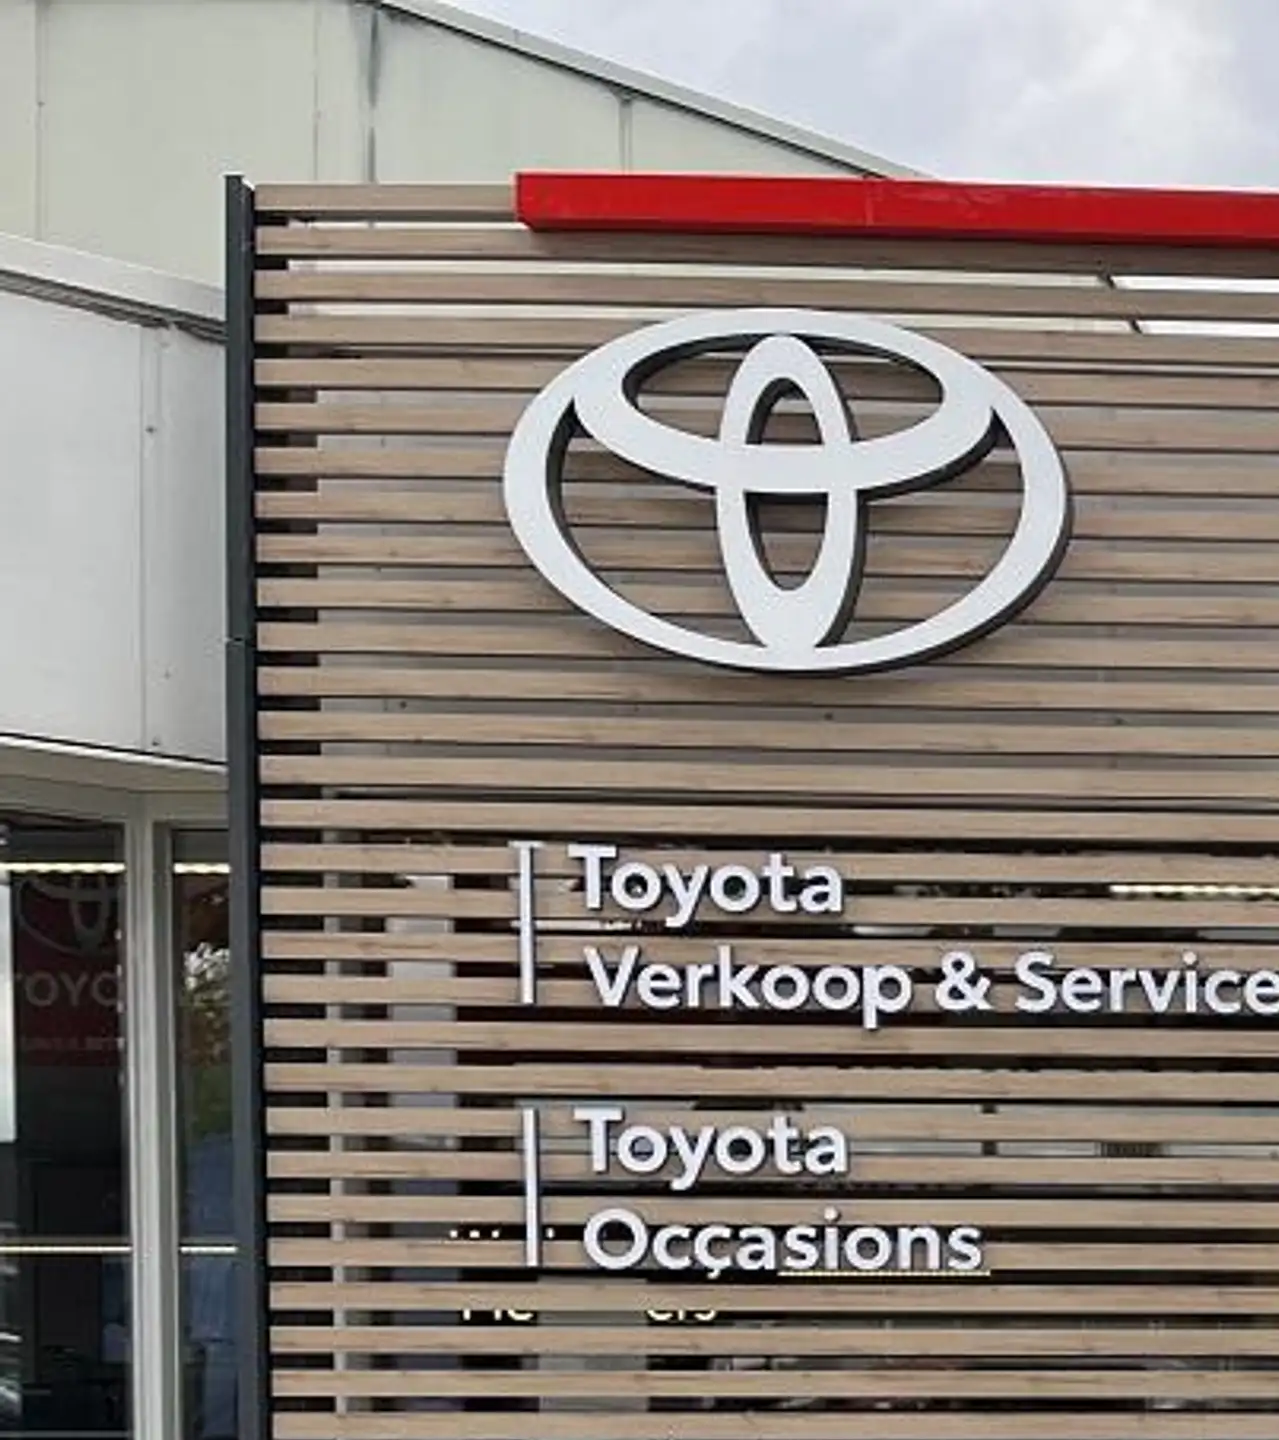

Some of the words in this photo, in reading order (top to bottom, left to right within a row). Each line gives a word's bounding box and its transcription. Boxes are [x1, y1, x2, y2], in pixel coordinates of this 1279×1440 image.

[567, 843, 845, 928] Toyota
[583, 944, 912, 1029] Verkoop
[935, 950, 994, 1012] &
[573, 1106, 850, 1191] Toyota
